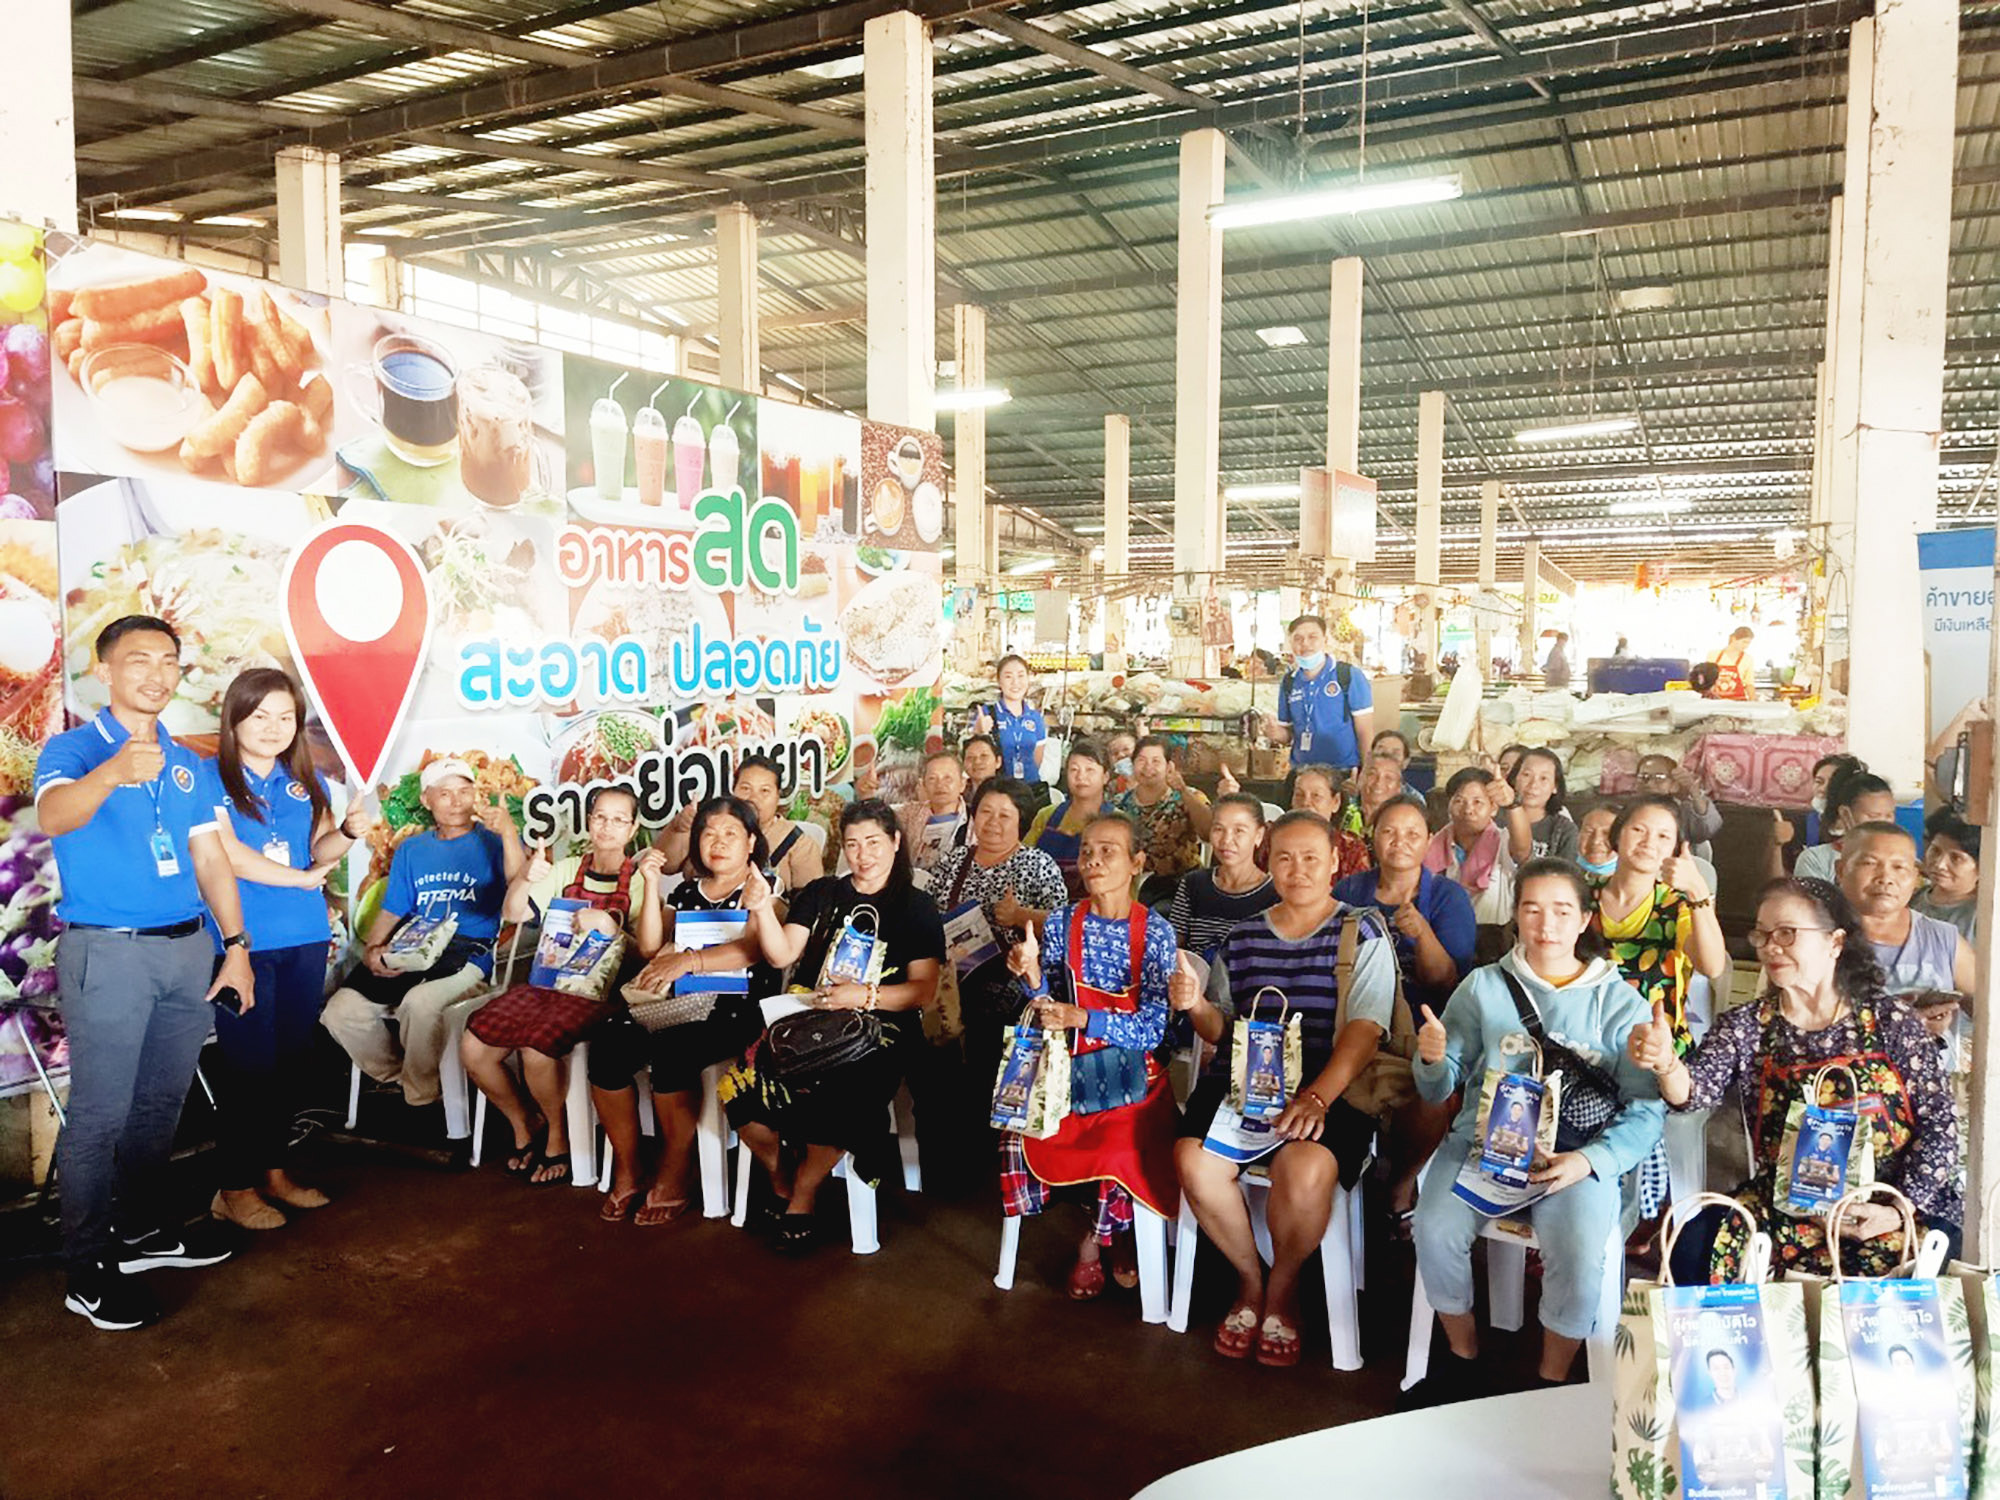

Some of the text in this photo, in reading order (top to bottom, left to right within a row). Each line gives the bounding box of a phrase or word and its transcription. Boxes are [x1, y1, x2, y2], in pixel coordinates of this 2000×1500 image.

[558, 491, 798, 590] อาหารสด
[459, 614, 841, 702] สะอาด ปลอดภัย
[462, 872, 478, 888] by
